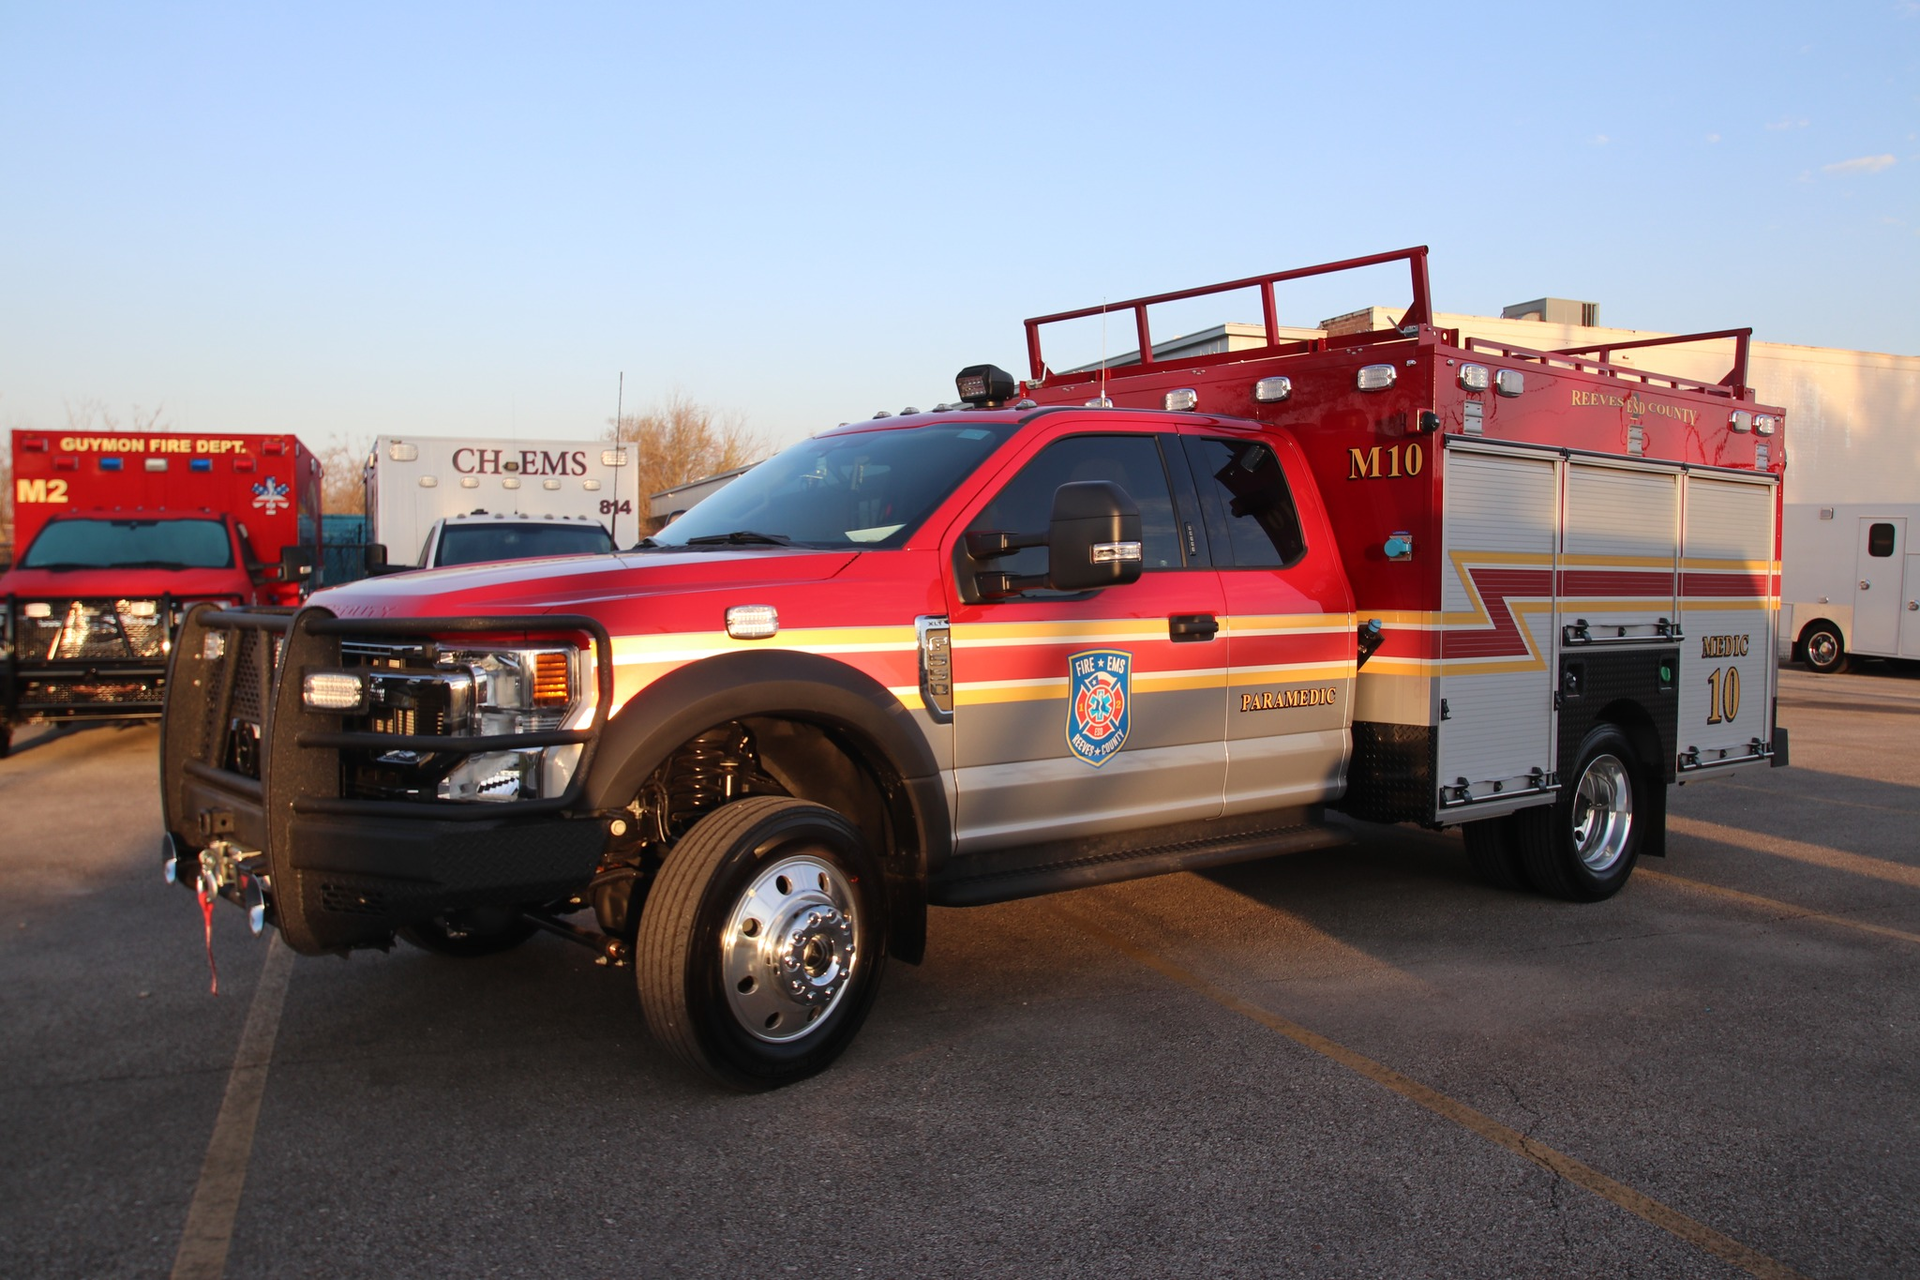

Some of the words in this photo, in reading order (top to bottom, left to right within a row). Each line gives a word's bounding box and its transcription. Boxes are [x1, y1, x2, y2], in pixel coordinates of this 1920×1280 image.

[1571, 389, 1624, 407] REEVES
[1627, 399, 1645, 415] ESD
[1648, 401, 1697, 426] COUNTY
[60, 437, 145, 452] GUYMON
[150, 438, 192, 453] FIRE
[196, 439, 247, 454] DEPT.
[452, 448, 503, 475] CH
[518, 450, 587, 477] EMS
[1348, 442, 1423, 480] M10
[16, 478, 69, 504] M2
[599, 499, 632, 515] 814
[1702, 634, 1749, 659] MEDIC
[1075, 656, 1096, 677] FIRE
[1106, 655, 1126, 674] EMS
[1115, 700, 1122, 709] 2
[1240, 686, 1337, 712] PARAMEDIC
[1706, 665, 1740, 726] 10
[1071, 733, 1095, 757] REEVES
[1101, 729, 1125, 755] COUNTY
